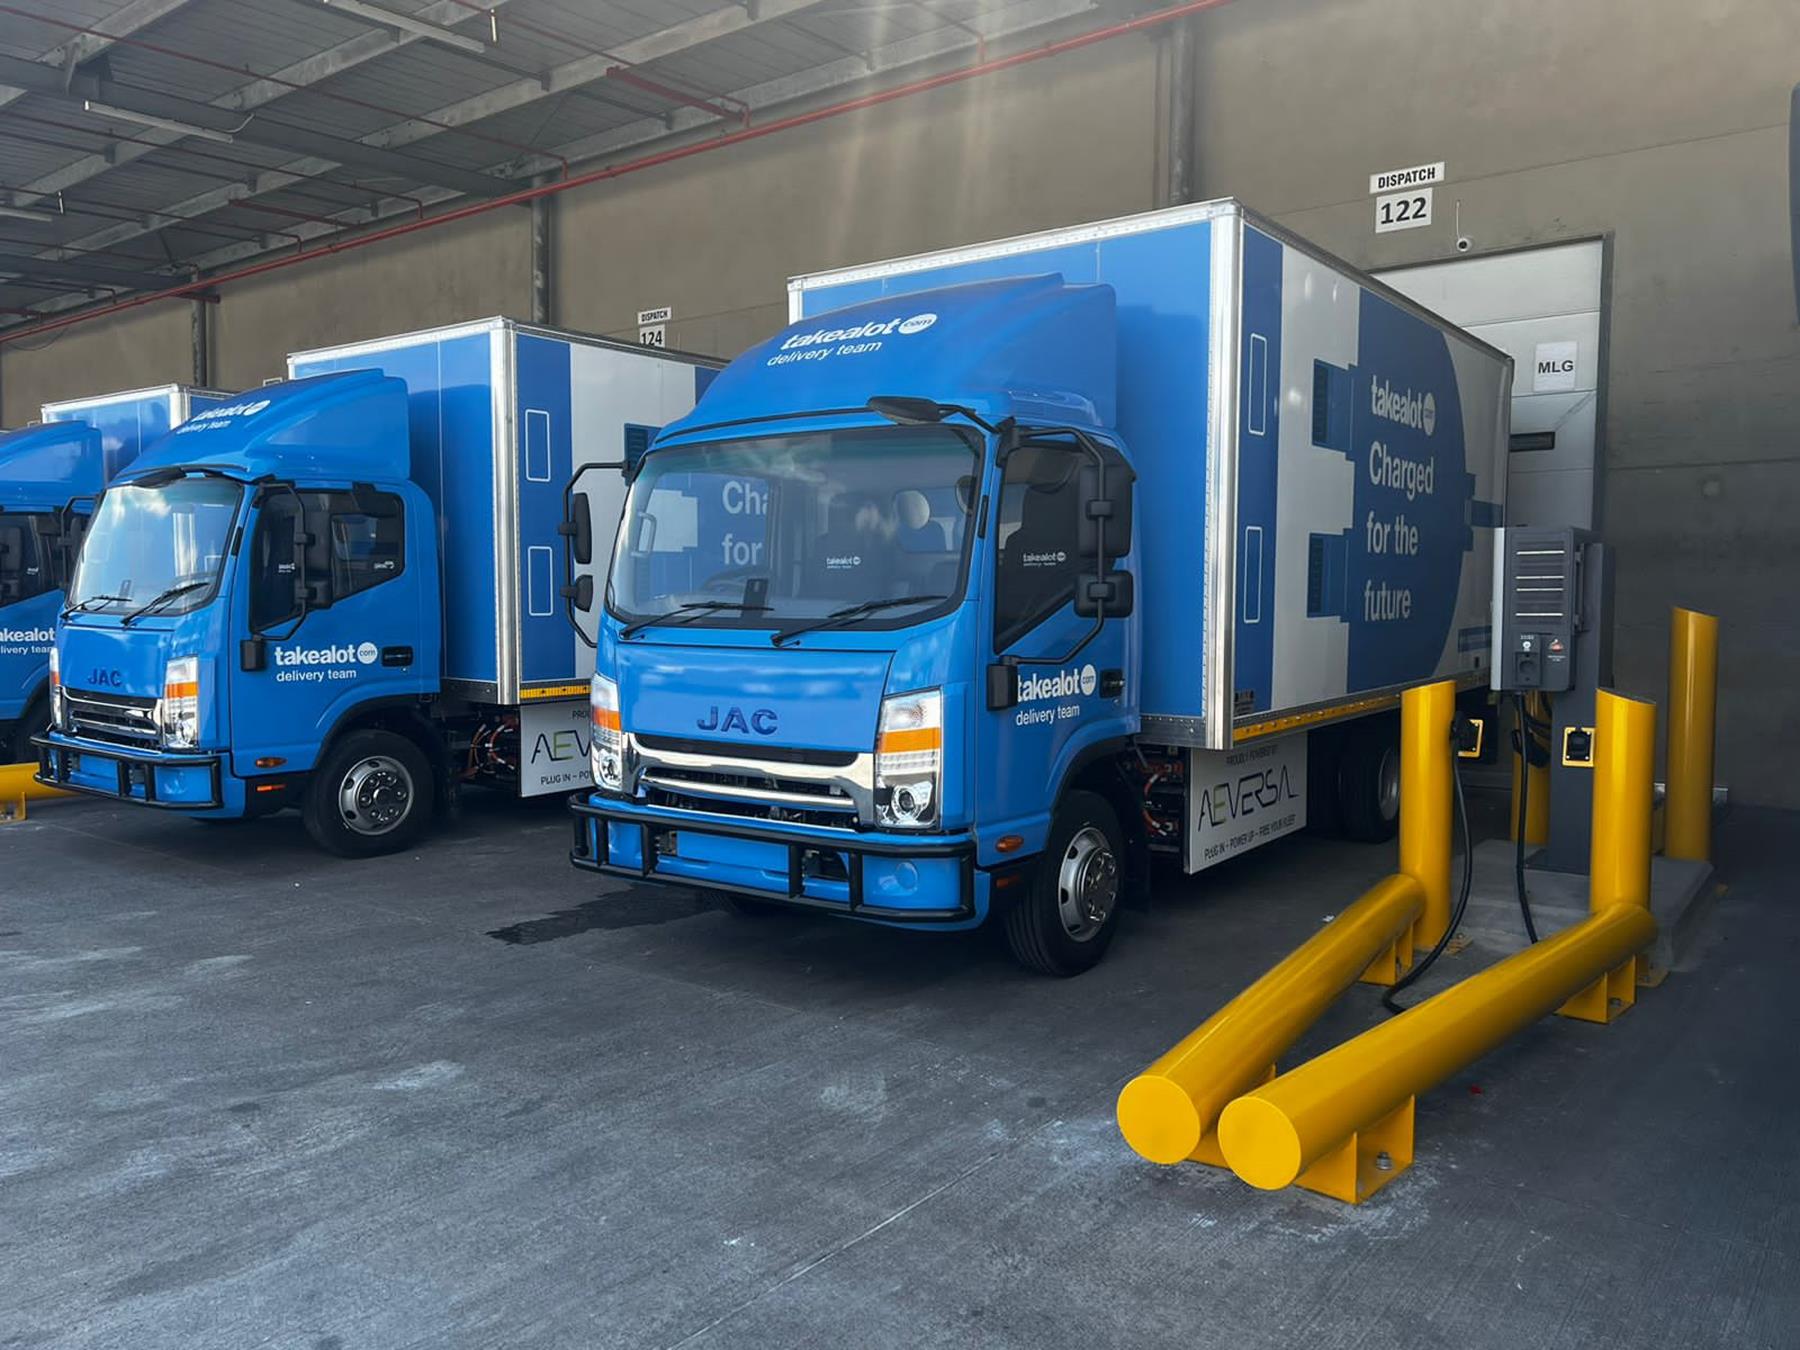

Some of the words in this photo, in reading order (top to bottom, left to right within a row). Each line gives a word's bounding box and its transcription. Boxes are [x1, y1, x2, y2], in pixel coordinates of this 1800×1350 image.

[1378, 167, 1436, 189] DISPATCH
[1380, 197, 1427, 225] 122
[641, 310, 668, 322] DISPATCH
[641, 330, 662, 346] 124
[780, 318, 902, 350] takealot
[767, 347, 834, 367] delivery
[837, 341, 882, 355] team
[1537, 360, 1574, 374] MLG
[1371, 374, 1422, 429] takealot
[1369, 440, 1434, 501] Charged
[1366, 510, 1391, 554] for
[1394, 514, 1419, 555] the
[721, 533, 763, 566] for
[1364, 579, 1411, 621] future
[0, 627, 55, 642] kealot
[274, 644, 356, 666] takealot
[87, 668, 121, 687] JAC
[276, 670, 324, 683] delivery
[327, 668, 357, 680] team
[1017, 667, 1080, 702] takealot
[696, 705, 778, 735] JAC
[1016, 709, 1055, 726] delivery
[1057, 705, 1080, 720] team
[540, 774, 561, 785] PLUG
[563, 773, 572, 783] IN
